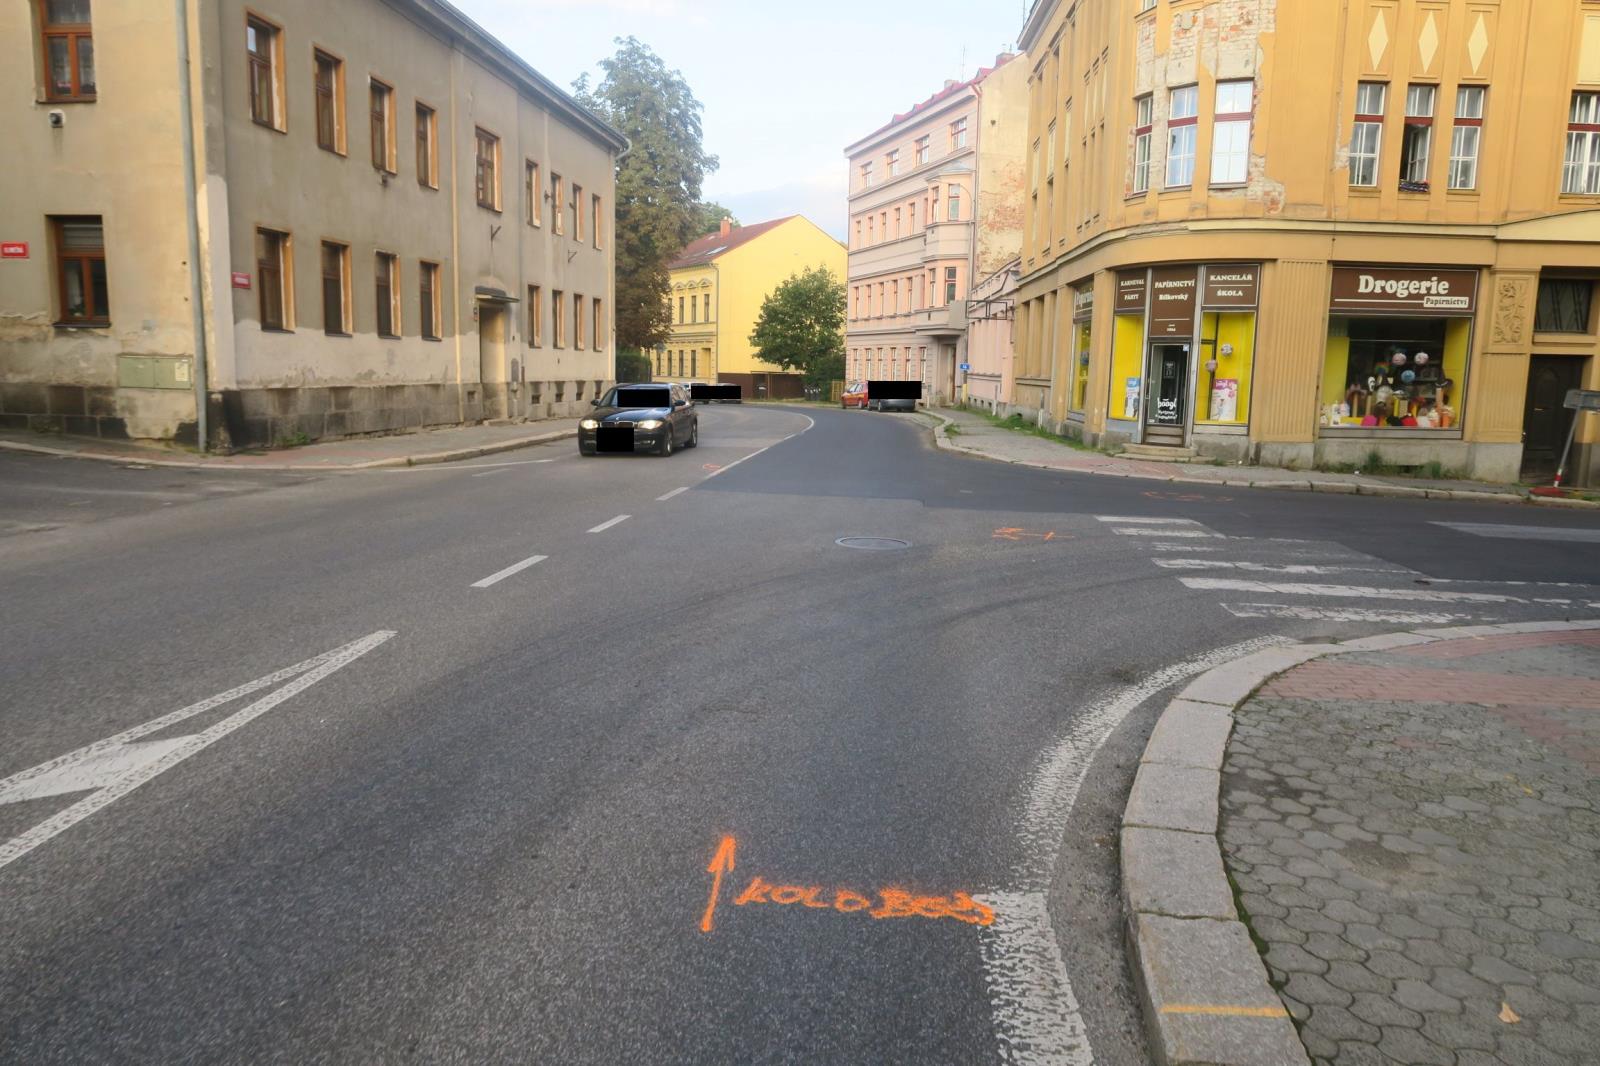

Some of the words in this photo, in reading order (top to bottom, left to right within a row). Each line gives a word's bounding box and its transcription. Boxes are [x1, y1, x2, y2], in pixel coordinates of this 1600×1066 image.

[1120, 279, 1145, 287] KARNEVAL
[1154, 278, 1196, 289] PAPÍRNICTVÍ
[1357, 275, 1449, 298] Drogerie
[1216, 289, 1243, 297] ŠKOLA
[1425, 297, 1467, 307] Papírnictví
